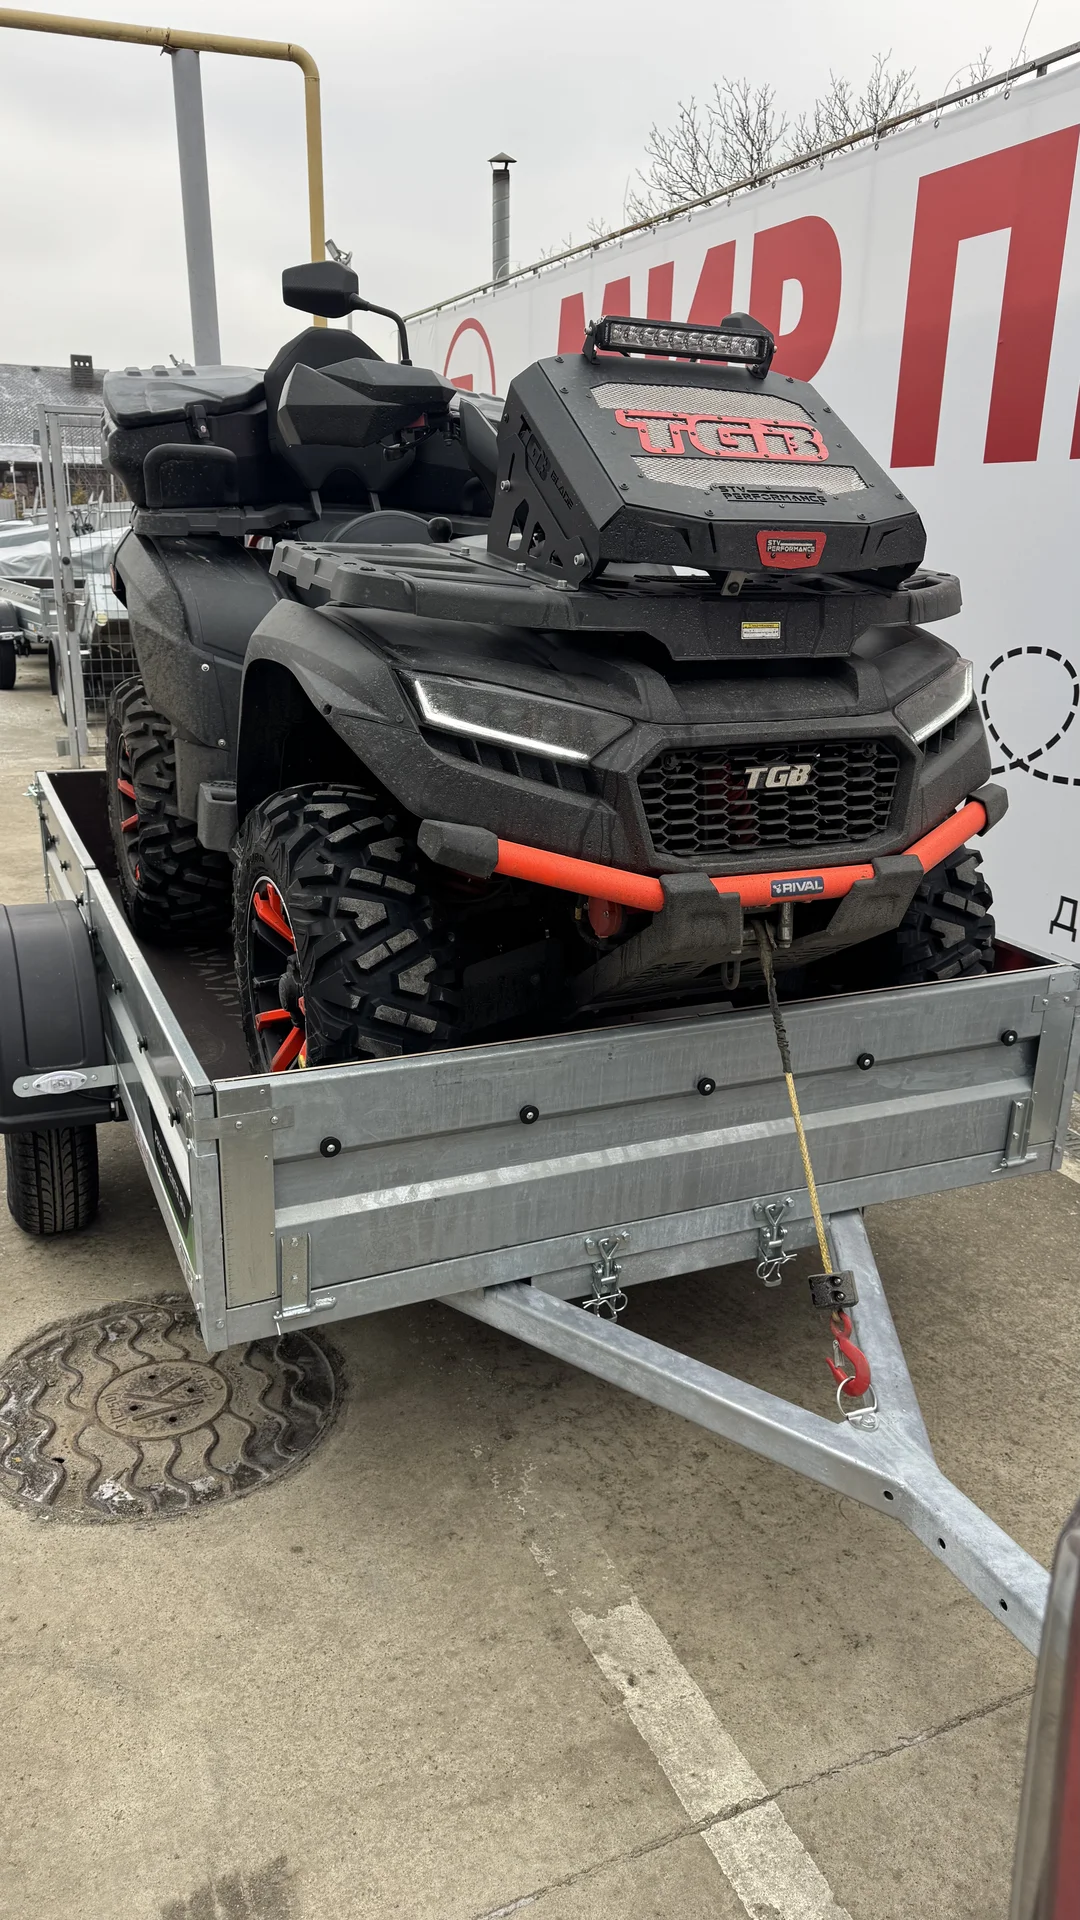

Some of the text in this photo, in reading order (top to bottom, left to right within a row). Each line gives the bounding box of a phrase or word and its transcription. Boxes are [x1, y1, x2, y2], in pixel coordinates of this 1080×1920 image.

[889, 123, 1080, 468] П
[614, 409, 829, 462] TGB
[518, 414, 551, 481] TGB
[719, 485, 746, 493] STV
[722, 492, 828, 503] PERFORMANCE
[767, 545, 815, 553] PERFORMANCE
[744, 764, 811, 789] TGB
[782, 880, 823, 893] RIVAL
